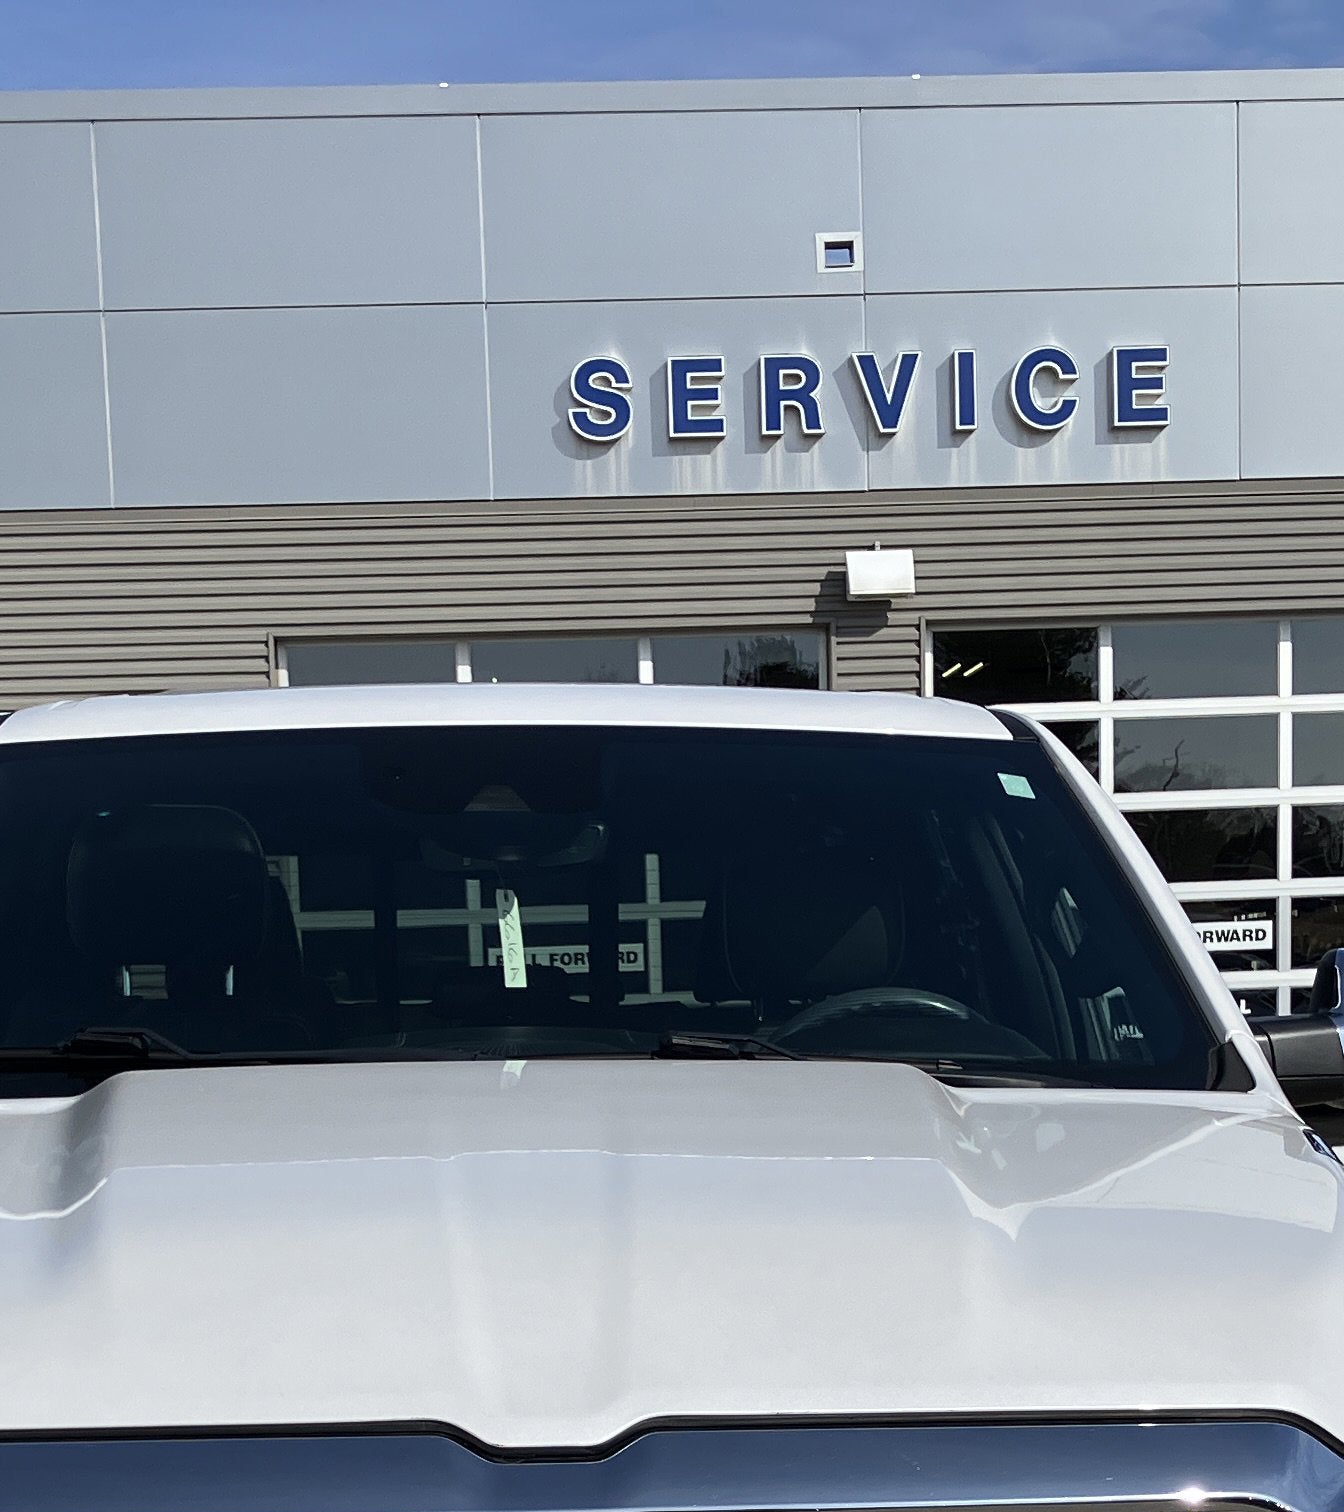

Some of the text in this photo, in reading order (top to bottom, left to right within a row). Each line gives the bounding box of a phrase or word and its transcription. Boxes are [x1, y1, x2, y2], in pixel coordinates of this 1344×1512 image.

[567, 344, 1170, 442] SERVICE
[1197, 928, 1267, 944] RWARD
[550, 951, 638, 967] FORRD
